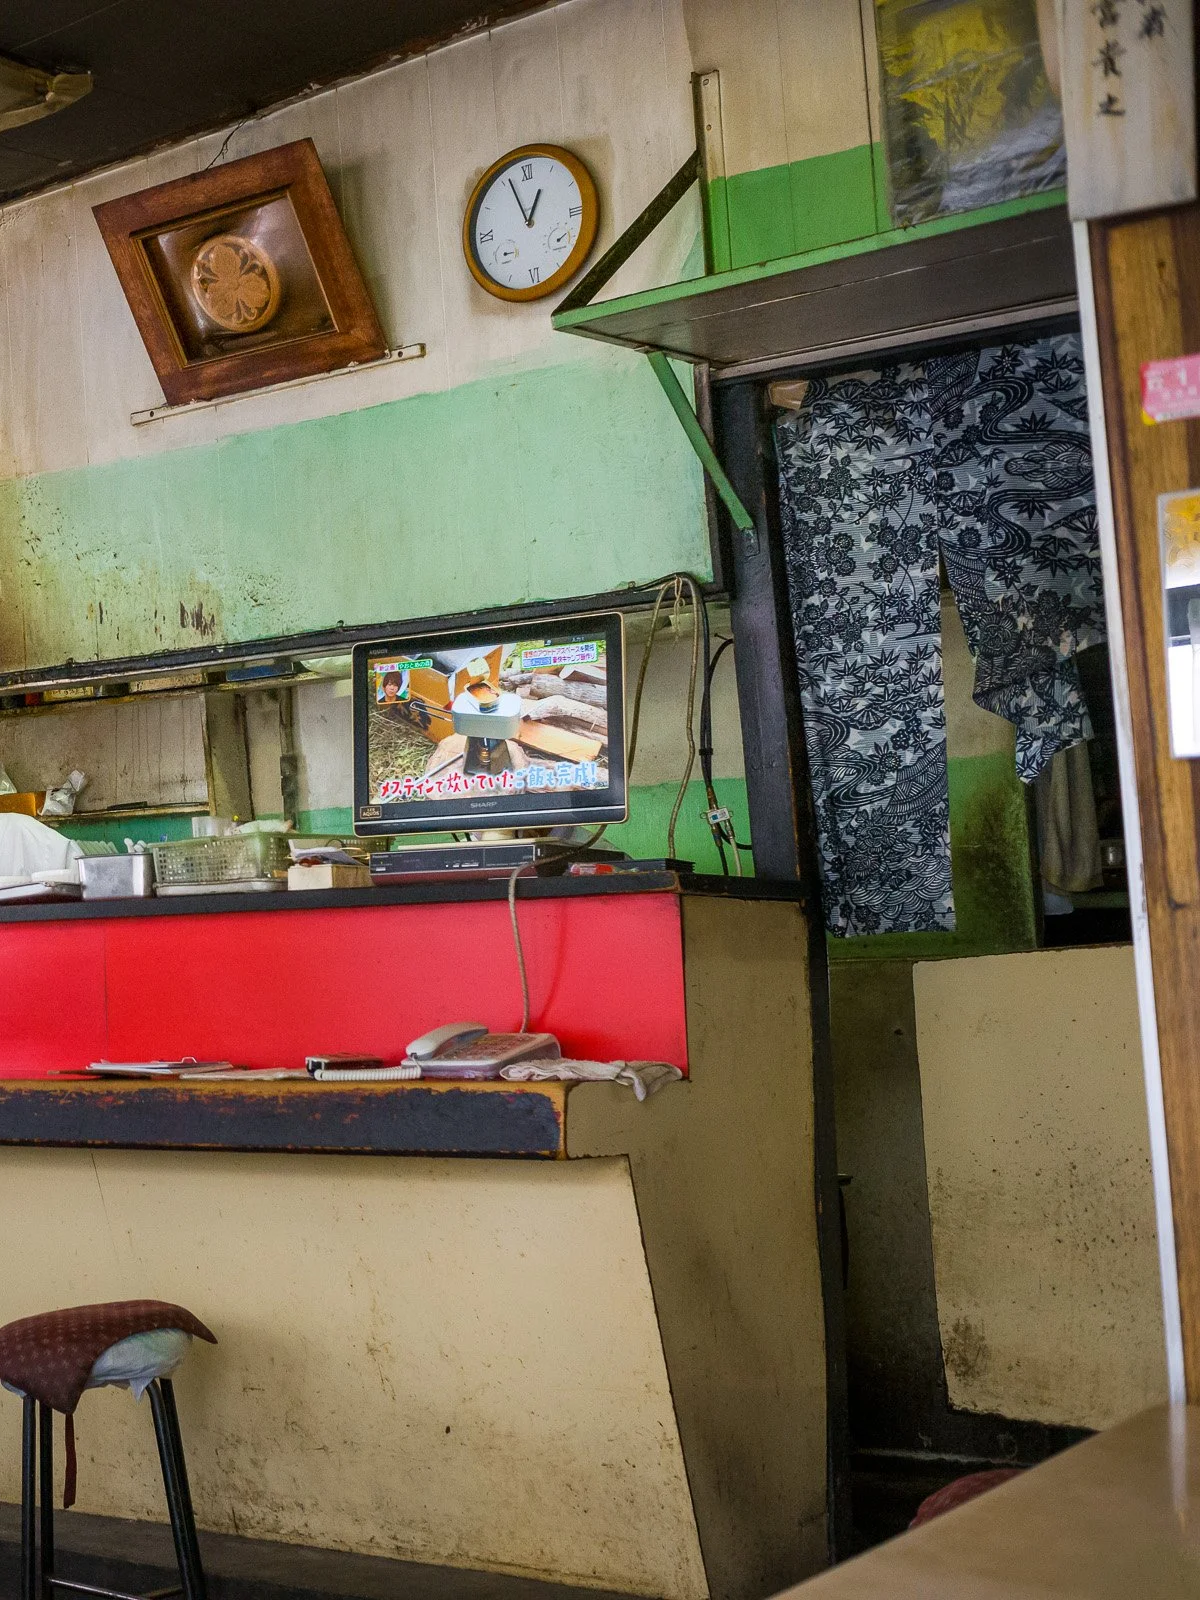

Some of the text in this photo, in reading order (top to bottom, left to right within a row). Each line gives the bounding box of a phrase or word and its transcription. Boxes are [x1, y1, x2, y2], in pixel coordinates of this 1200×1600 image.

[521, 164, 533, 181] XII
[480, 229, 493, 244] IX
[528, 267, 540, 284] VI
[470, 801, 498, 809] SHARP
